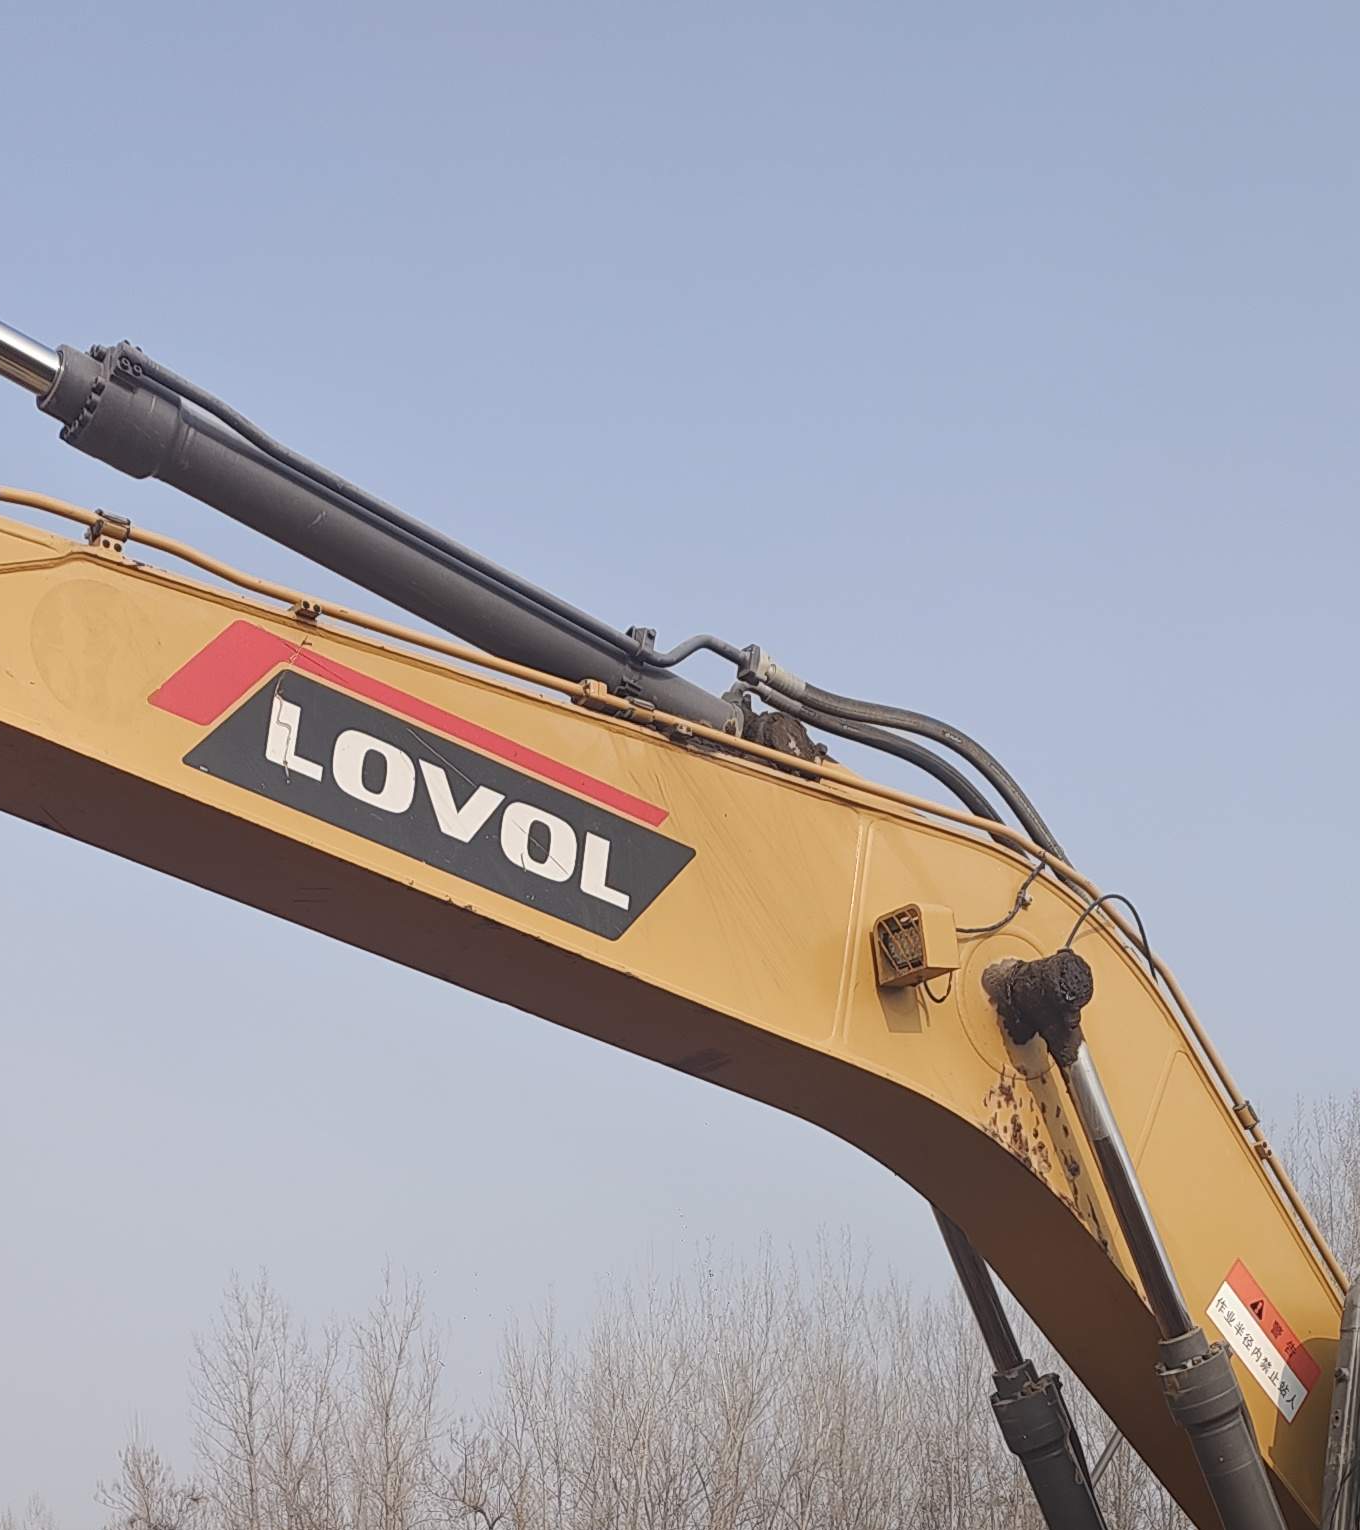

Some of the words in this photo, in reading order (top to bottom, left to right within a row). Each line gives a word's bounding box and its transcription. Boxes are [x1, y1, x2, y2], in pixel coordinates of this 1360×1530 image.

[265, 695, 630, 910] LOVOL
[1215, 1297, 1297, 1410] 作业半径内禁止站人
[1271, 1319, 1297, 1359] 警告
